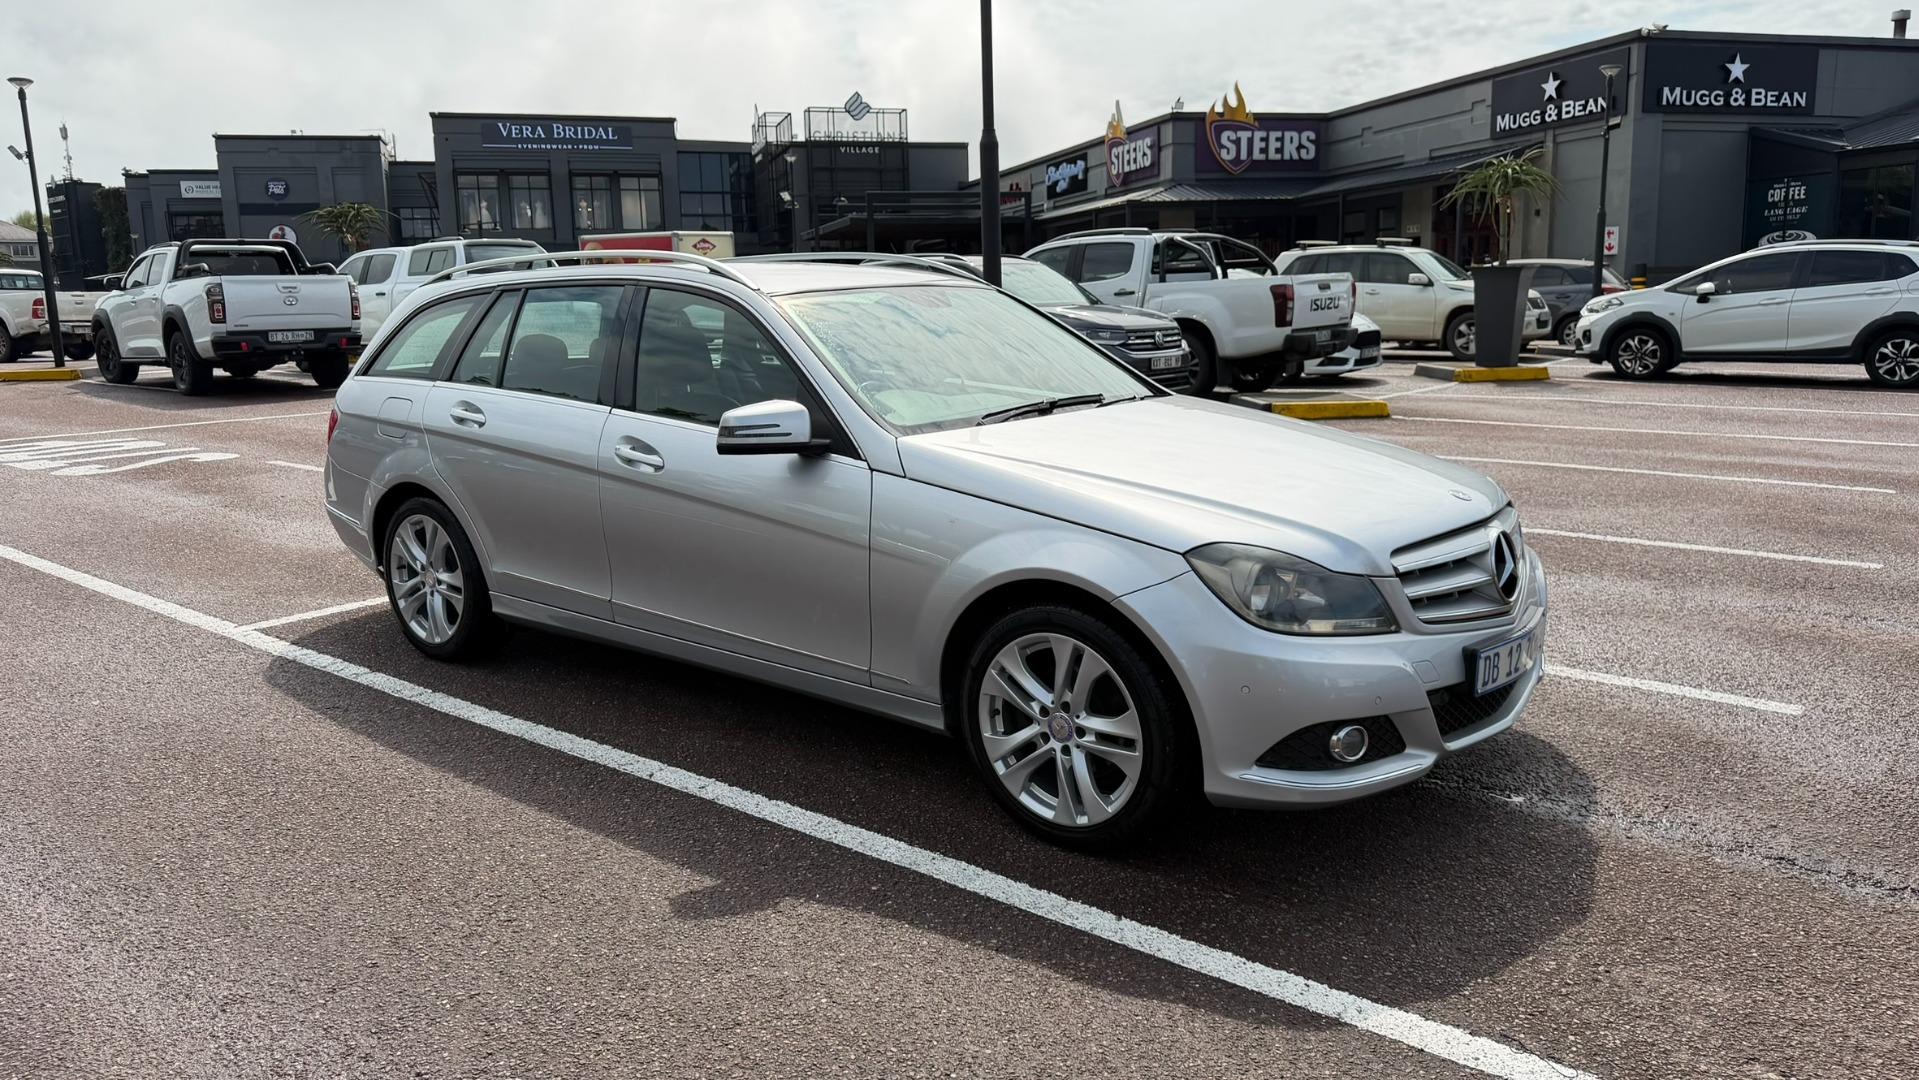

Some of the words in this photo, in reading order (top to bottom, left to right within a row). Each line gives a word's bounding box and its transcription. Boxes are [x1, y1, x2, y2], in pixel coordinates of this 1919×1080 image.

[1662, 86, 1724, 106] MUGG
[1730, 87, 1746, 107] &
[1751, 88, 1807, 107] BEAN
[1496, 109, 1541, 132] MUGG
[1545, 104, 1558, 122] &
[498, 122, 546, 139] VERA
[552, 123, 618, 140] BRIDAL
[840, 146, 880, 154] VILLAGE
[1111, 137, 1152, 175] STEERS
[1220, 130, 1316, 160] STEERS
[1309, 296, 1340, 312] ISUZU
[1481, 651, 1500, 688] DB
[1506, 642, 1522, 678] 12
